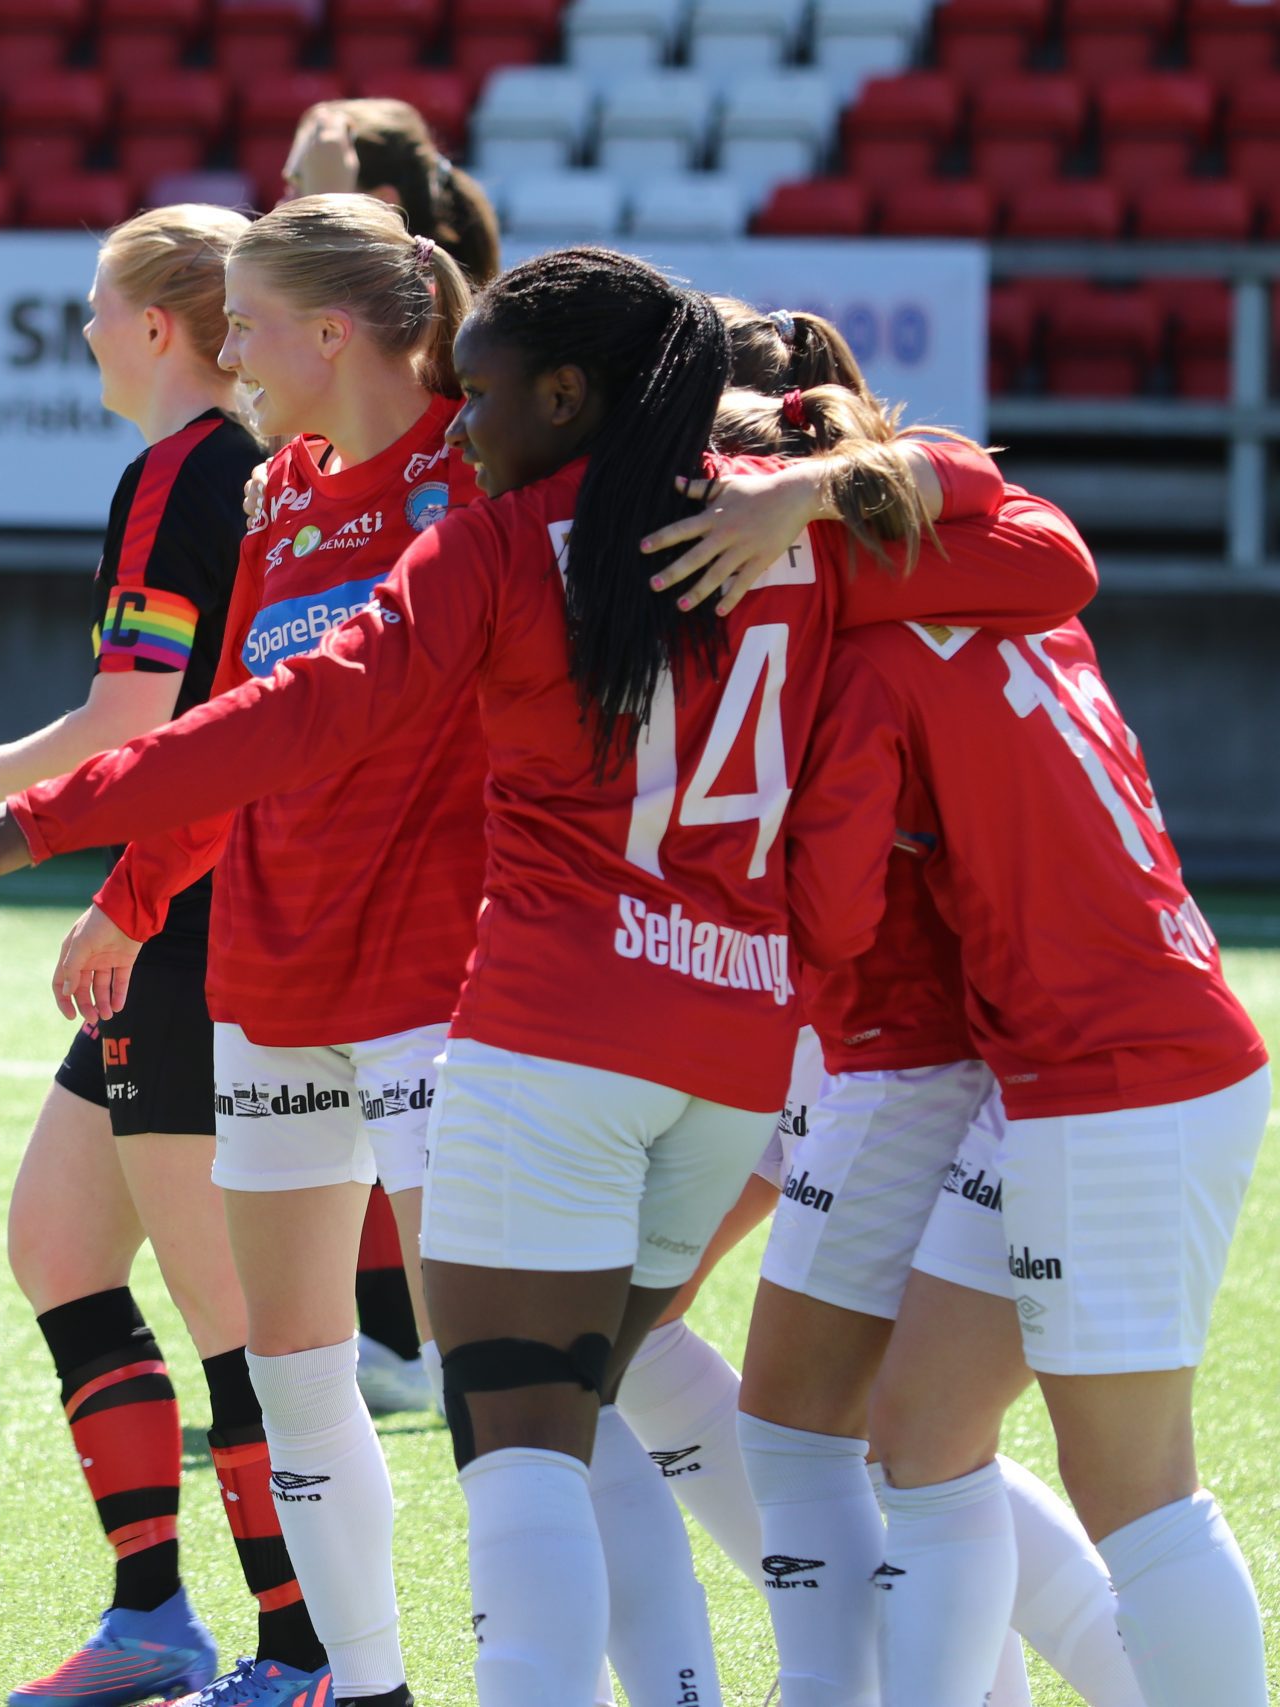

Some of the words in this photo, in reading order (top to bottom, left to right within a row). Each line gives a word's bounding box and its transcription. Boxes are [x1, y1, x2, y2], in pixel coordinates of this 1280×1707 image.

[109, 591, 147, 648] C
[614, 893, 796, 1006] Sebazung
[271, 1082, 350, 1116] dalen
[270, 1489, 323, 1503] mbro
[764, 1573, 820, 1589] mbro
